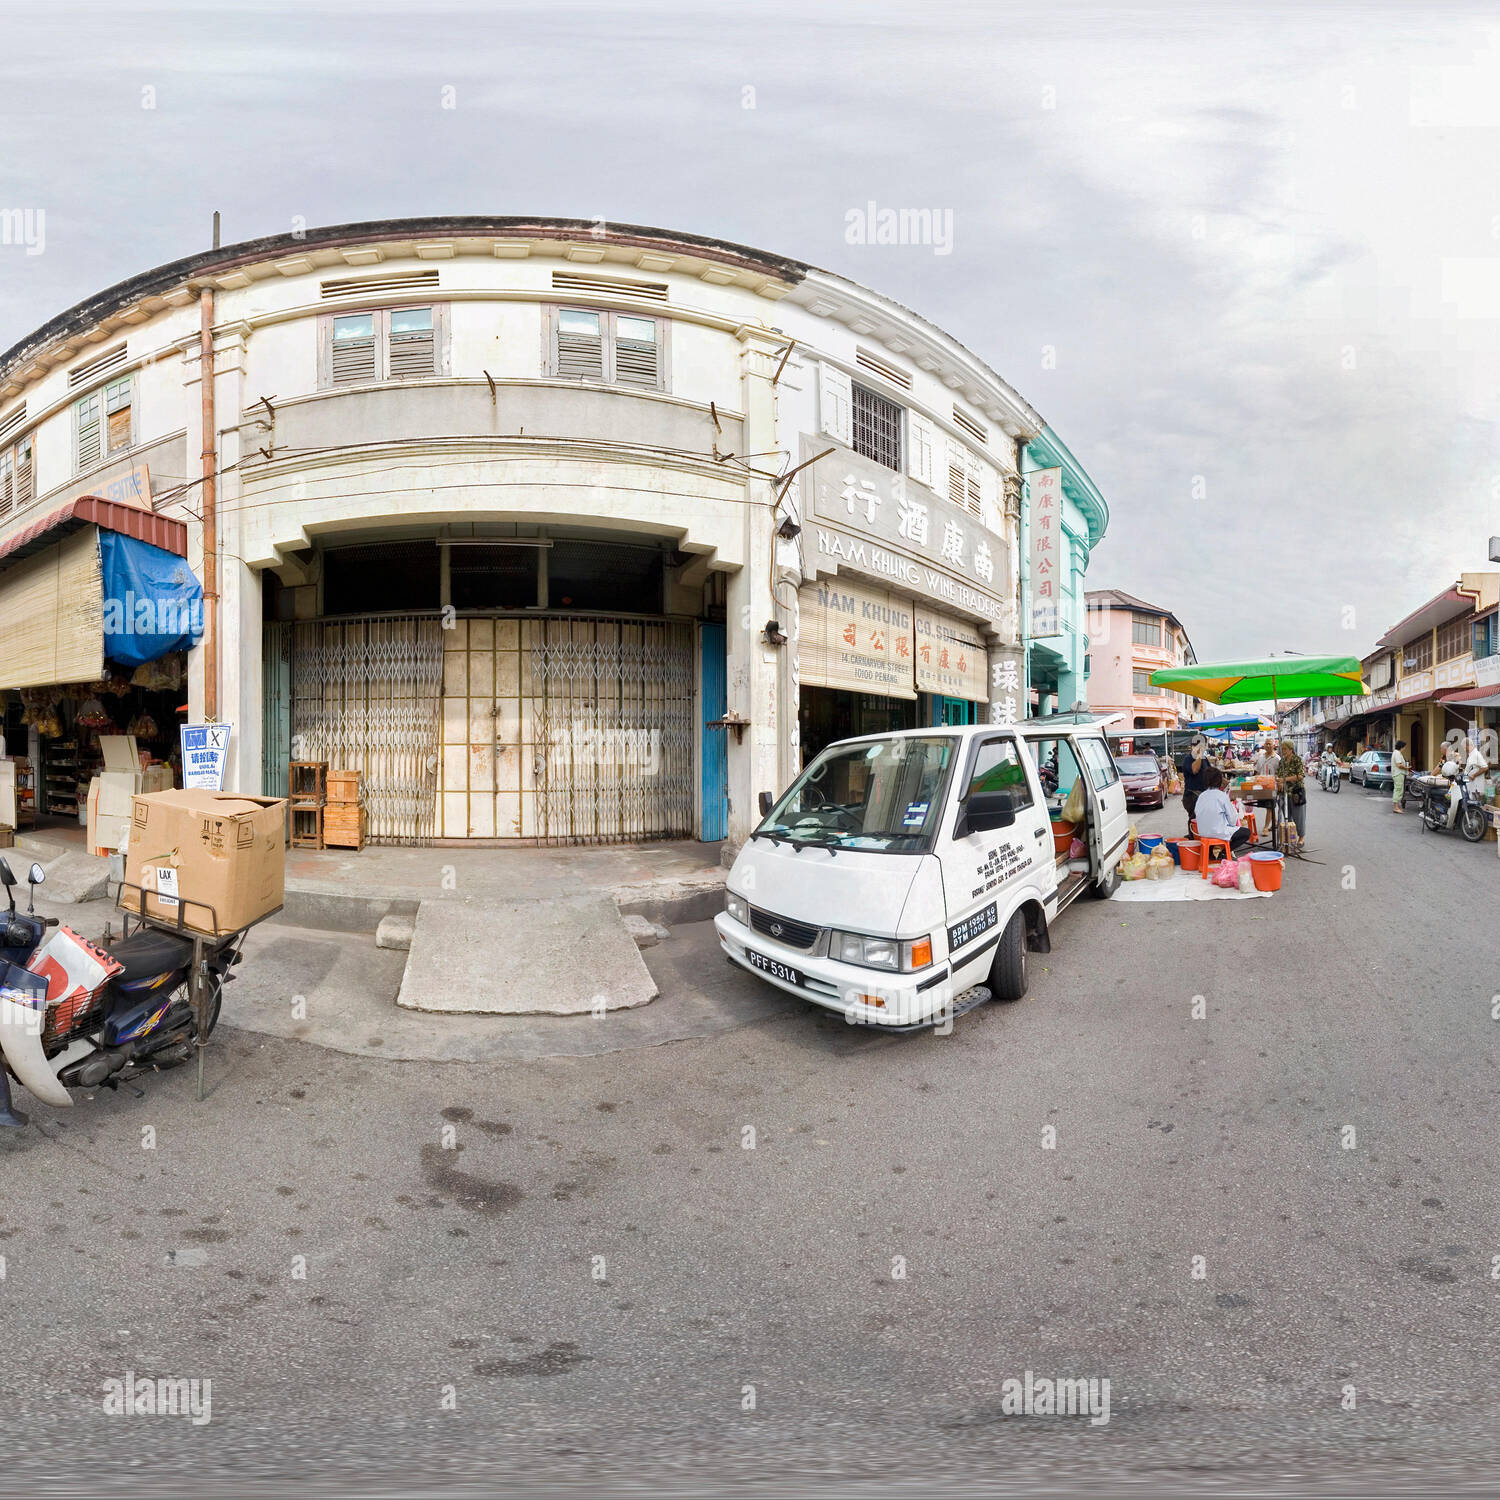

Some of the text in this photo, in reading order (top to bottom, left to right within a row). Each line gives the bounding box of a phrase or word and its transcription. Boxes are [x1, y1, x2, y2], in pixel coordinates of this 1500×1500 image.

[1036, 474, 1055, 598] 南康有限公司
[817, 529, 1001, 621] NAM KHUNG WINE TRADERS
[816, 588, 855, 615] NAM
[862, 600, 909, 630] KHUNG
[843, 624, 967, 673] 南康有限公司
[874, 670, 898, 684] PENANG
[887, 662, 910, 675] STREET
[159, 869, 171, 880] LAX
[952, 923, 968, 939] BDM
[953, 931, 969, 948] BTM
[750, 951, 797, 984] PFF 5314
